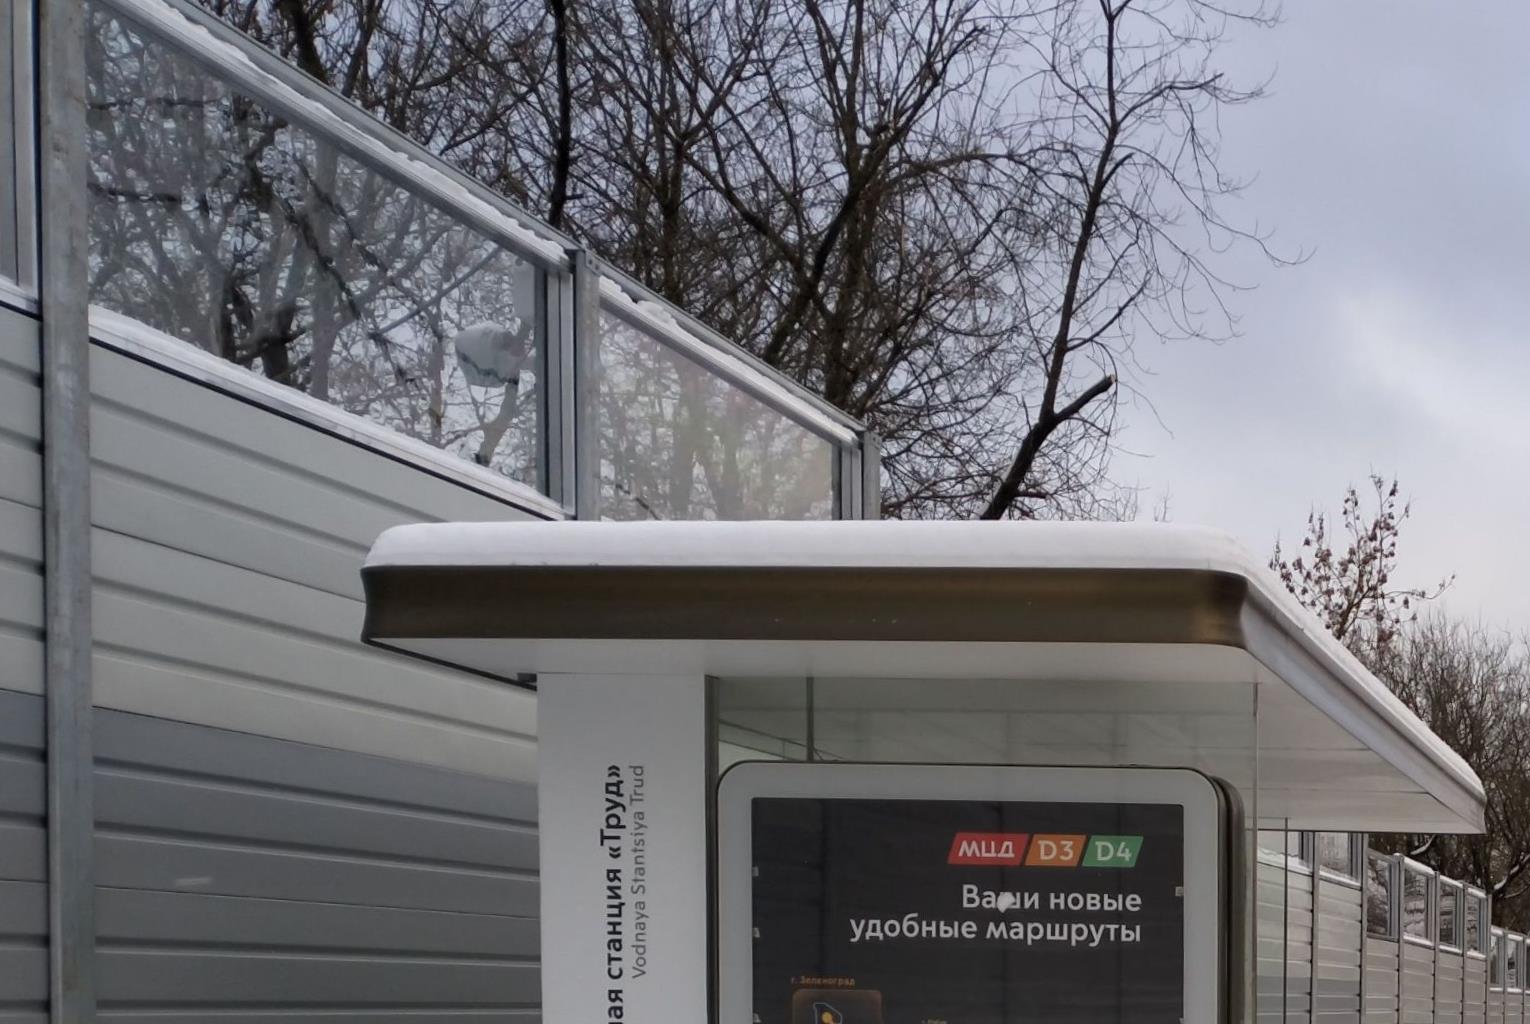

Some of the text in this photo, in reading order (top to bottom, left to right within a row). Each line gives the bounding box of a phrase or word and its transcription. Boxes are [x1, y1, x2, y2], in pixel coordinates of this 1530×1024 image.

[600, 764, 626, 859] «Труд»
[629, 764, 649, 979] Vodnaya Stantsiya Trud
[958, 839, 1133, 862] МЦД D3 D4
[605, 868, 626, 979] станция
[849, 912, 1141, 946] удобные маршруты
[1049, 892, 1142, 911] новые
